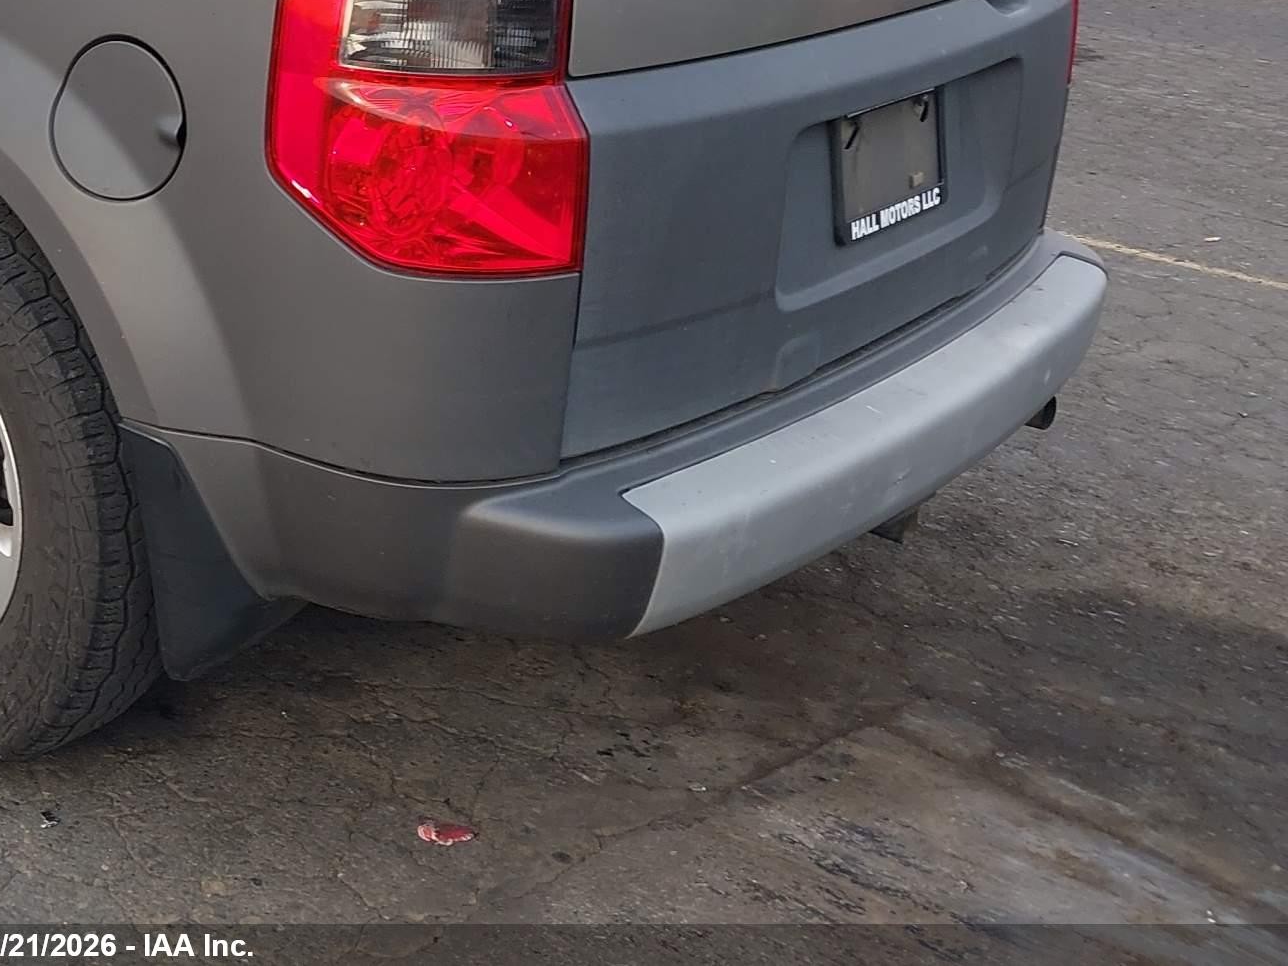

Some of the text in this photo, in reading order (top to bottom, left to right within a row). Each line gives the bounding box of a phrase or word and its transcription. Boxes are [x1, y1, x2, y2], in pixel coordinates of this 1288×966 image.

[851, 187, 941, 240] HALL MOTORS LLC
